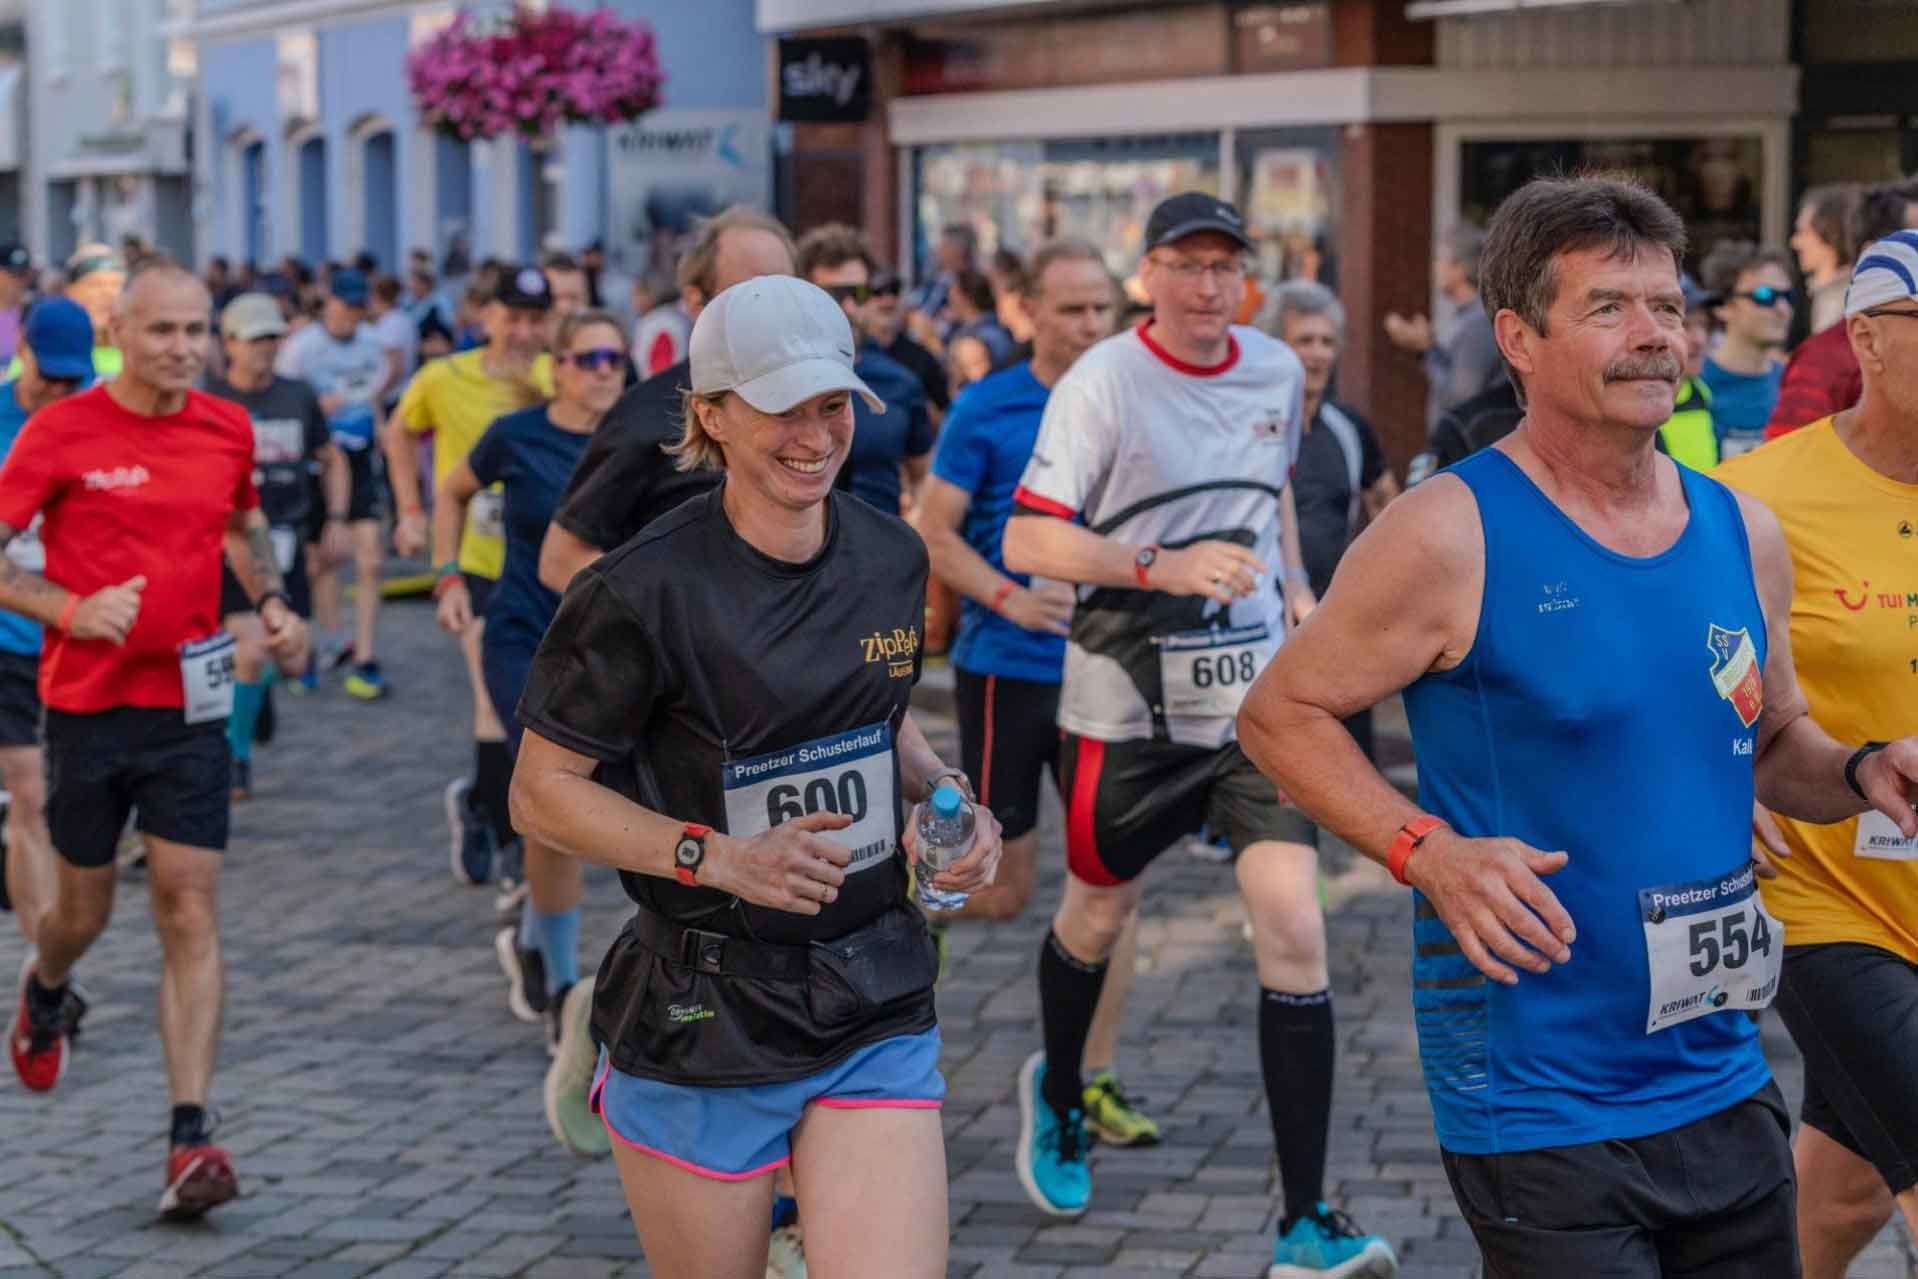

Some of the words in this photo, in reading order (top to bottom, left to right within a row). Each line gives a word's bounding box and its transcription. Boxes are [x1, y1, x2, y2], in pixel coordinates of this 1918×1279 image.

[783, 52, 861, 107] sky
[1878, 593, 1902, 608] TUI
[1193, 651, 1254, 688] 608
[735, 754, 795, 779] Preetzer
[800, 729, 881, 762] Schusterlauf
[767, 770, 867, 828] 600
[1654, 886, 1717, 907] Preetzer
[1689, 904, 1771, 977] 554
[1660, 992, 1706, 1014] KRIWAT
